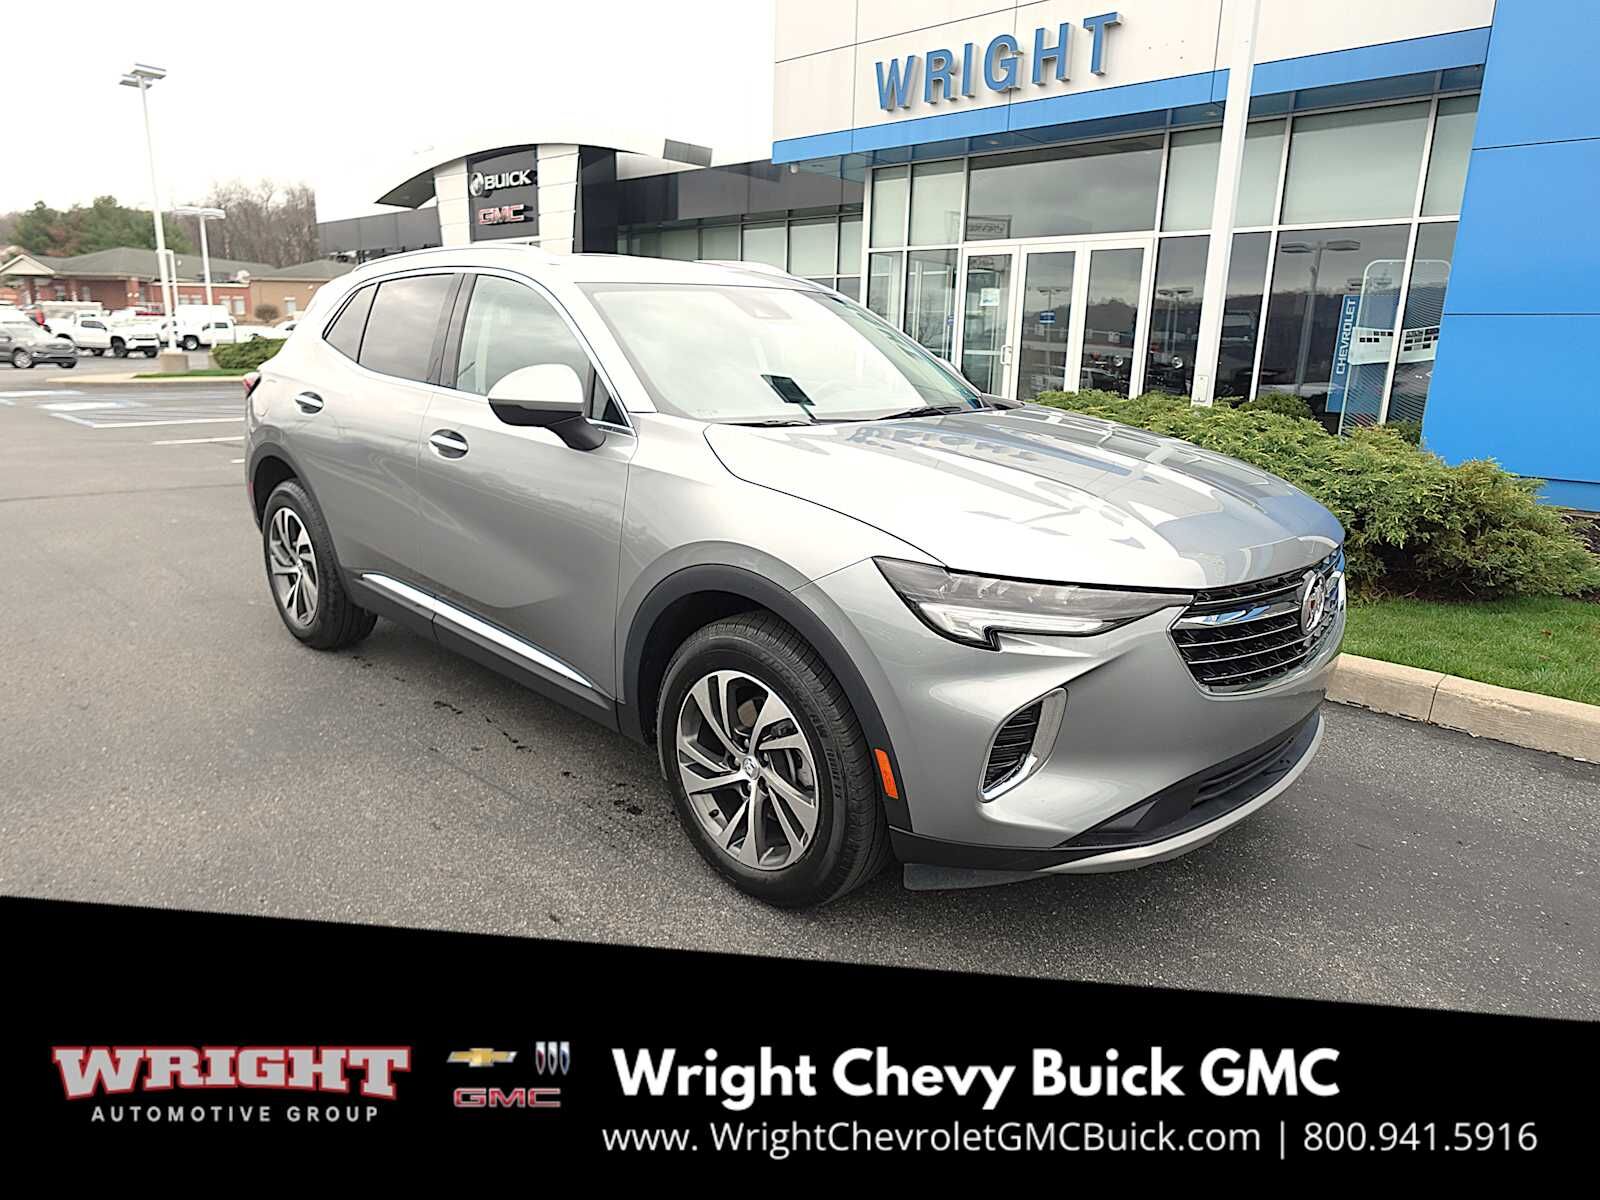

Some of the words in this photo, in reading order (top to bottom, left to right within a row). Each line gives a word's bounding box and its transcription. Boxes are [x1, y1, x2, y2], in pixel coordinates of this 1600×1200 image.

[875, 11, 1122, 111] WRIGHT
[484, 169, 532, 191] BUICK
[479, 204, 525, 225] GMC
[1335, 298, 1356, 374] CHEVROLET
